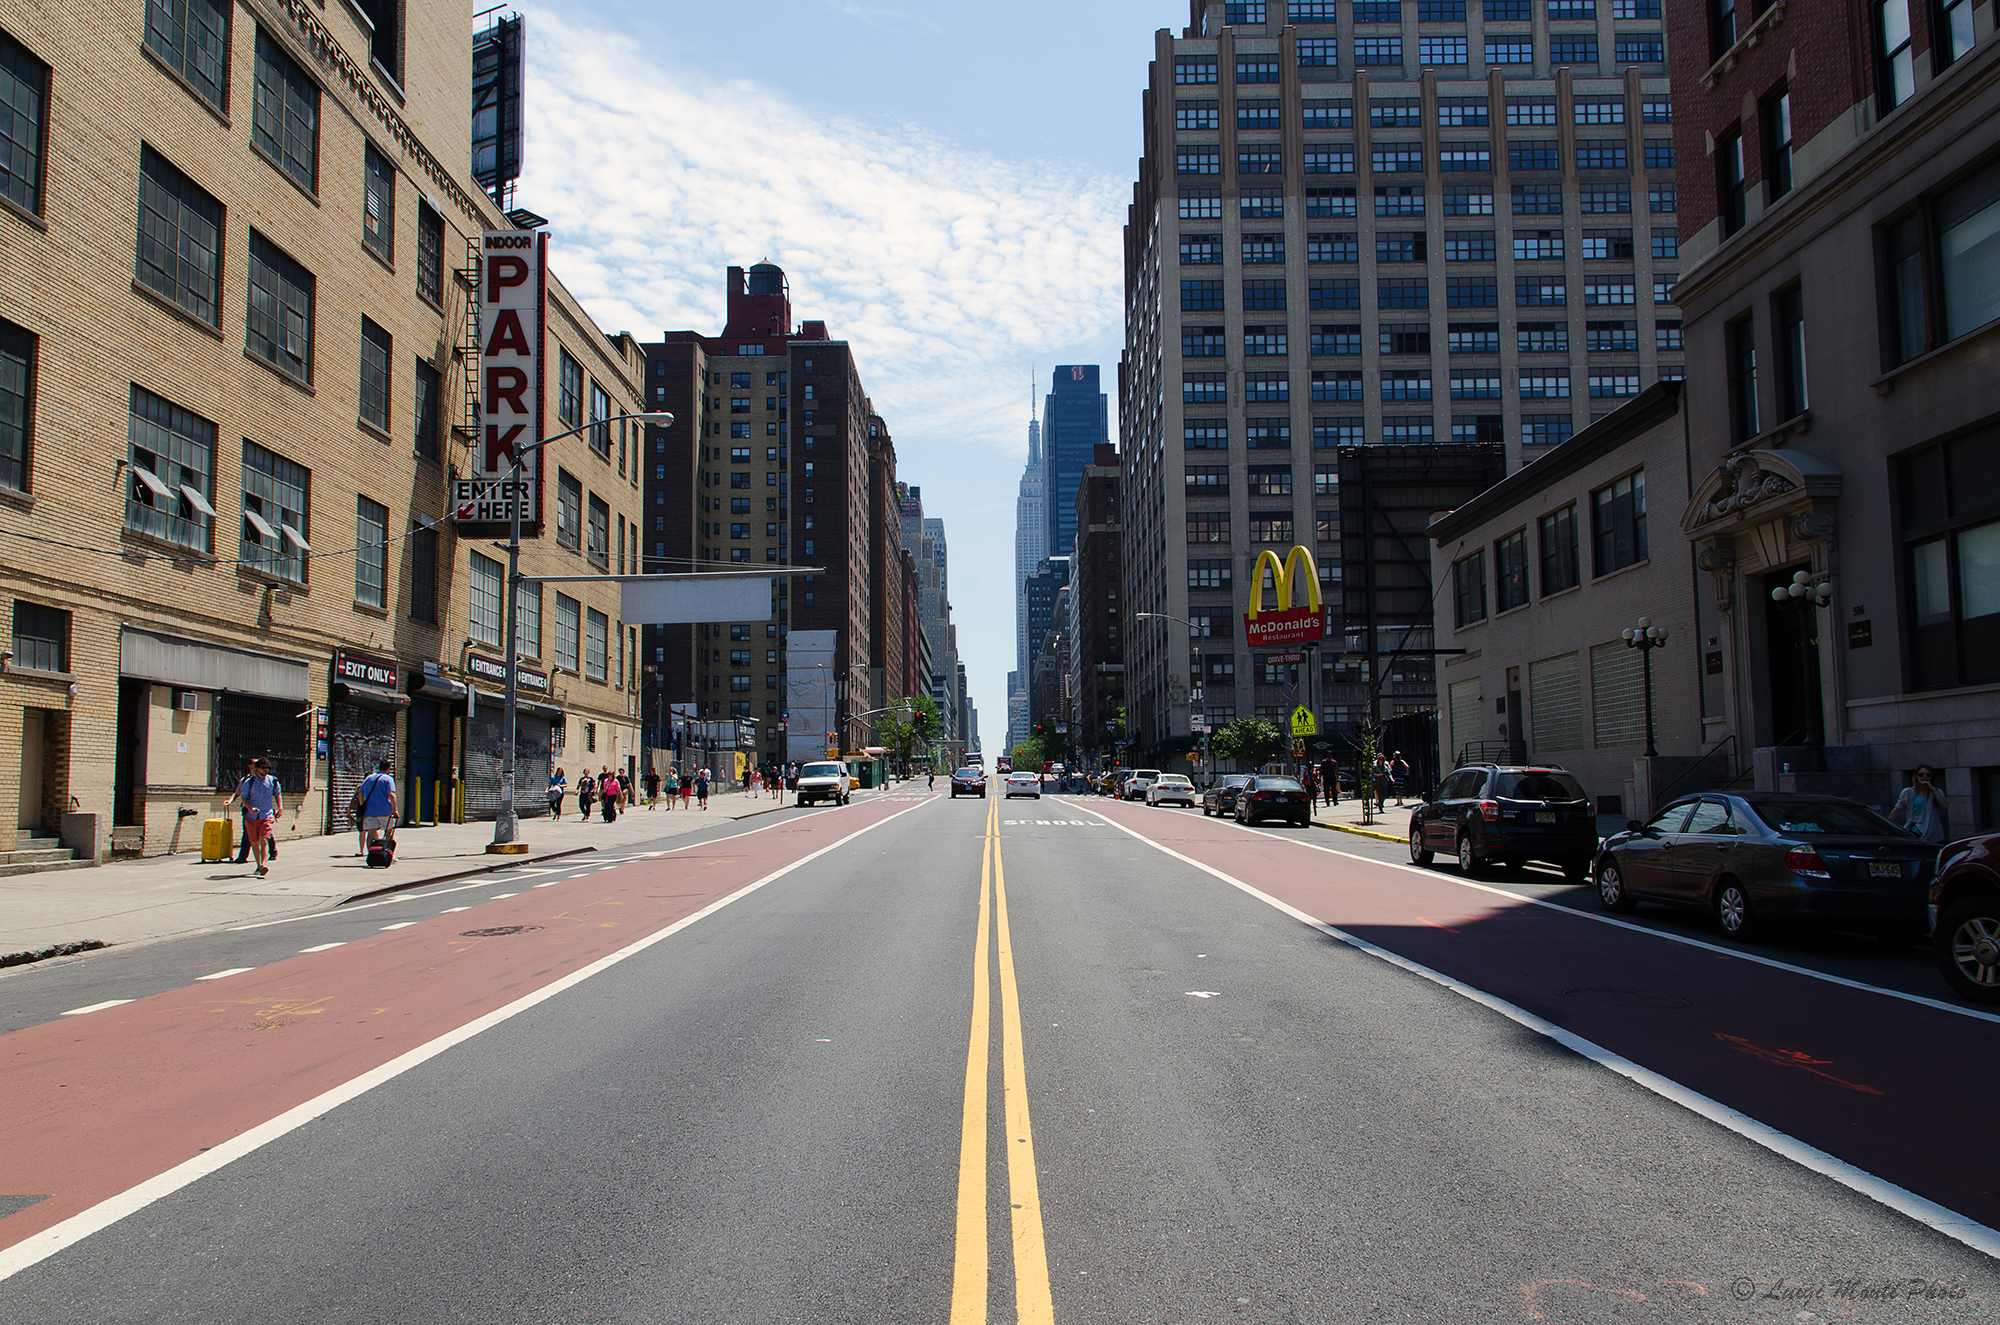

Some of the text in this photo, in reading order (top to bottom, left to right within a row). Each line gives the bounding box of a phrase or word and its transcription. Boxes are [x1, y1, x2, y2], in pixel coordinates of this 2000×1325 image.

[485, 236, 531, 250] INDOOR
[486, 256, 530, 472] PARK
[457, 482, 529, 500] ENTER
[477, 502, 529, 519] HERE
[1853, 605, 1865, 616] 516
[1249, 617, 1320, 635] McDonald's
[1262, 631, 1304, 641] Restaurant
[1268, 653, 1301, 664] DRIVE-THRU
[345, 661, 390, 684] EXIT ONLY
[475, 659, 503, 678] ENTRANCE
[521, 673, 544, 688] ENTRANCE
[1294, 726, 1314, 735] AHEAD
